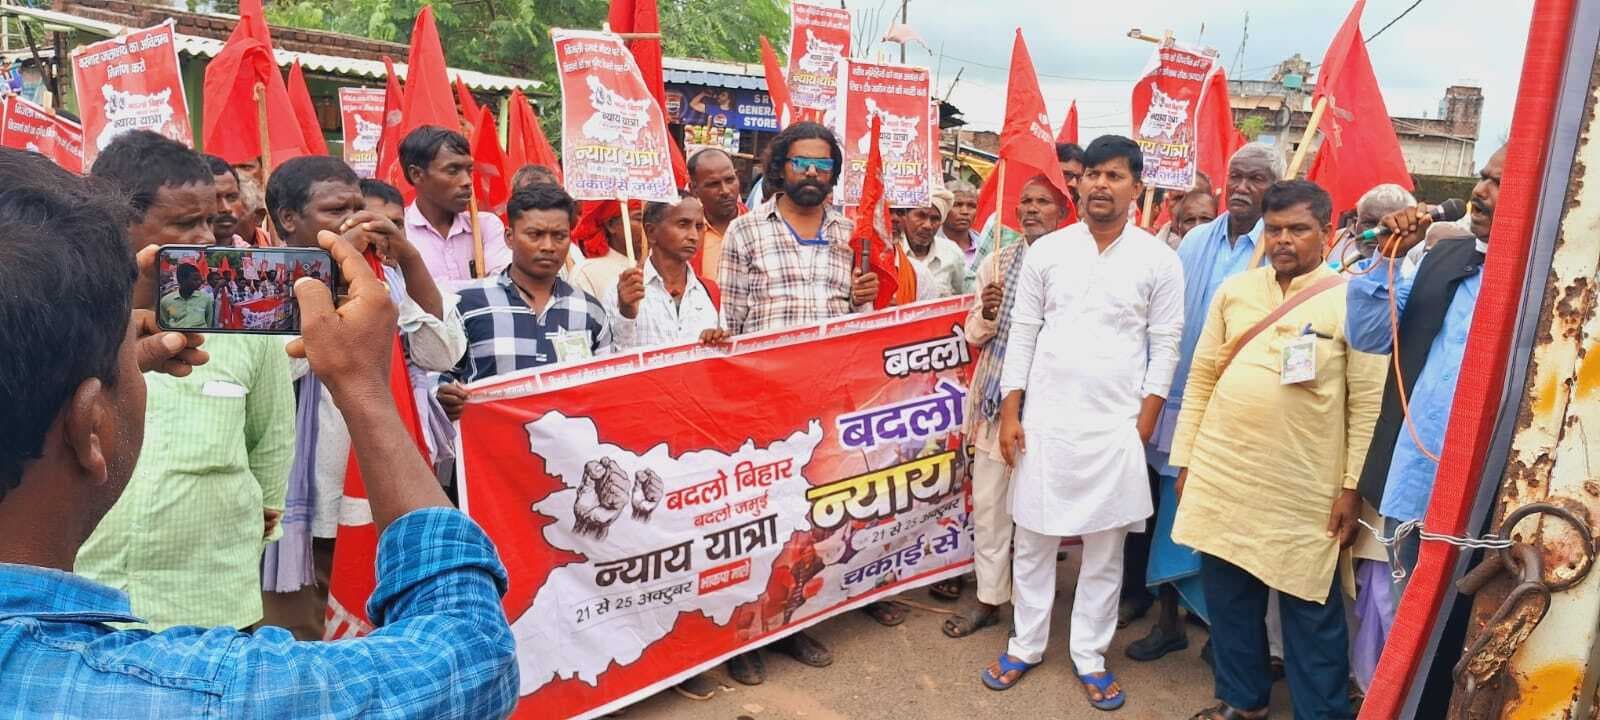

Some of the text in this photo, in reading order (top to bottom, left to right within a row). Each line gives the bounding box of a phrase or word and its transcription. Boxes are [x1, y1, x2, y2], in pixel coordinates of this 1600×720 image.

[114, 113, 162, 128] न्याय यात्रा
[738, 104, 777, 117] GENERA
[744, 117, 777, 129] STORE
[575, 145, 661, 168] न्याय यात्रा
[883, 324, 971, 377] बदलो
[839, 381, 966, 448] बदलो
[665, 457, 794, 511] बदलो बिहार
[807, 452, 956, 529] न्याय
[693, 489, 769, 528] बदलो जमुई
[594, 513, 778, 587] न्याय यात्रा
[871, 531, 885, 544] 21
[889, 521, 903, 537] से
[904, 517, 917, 531] 25
[843, 534, 925, 585] चकाई
[932, 526, 961, 554] से
[575, 606, 591, 623] 21
[596, 597, 610, 615] से
[615, 594, 632, 609] 25
